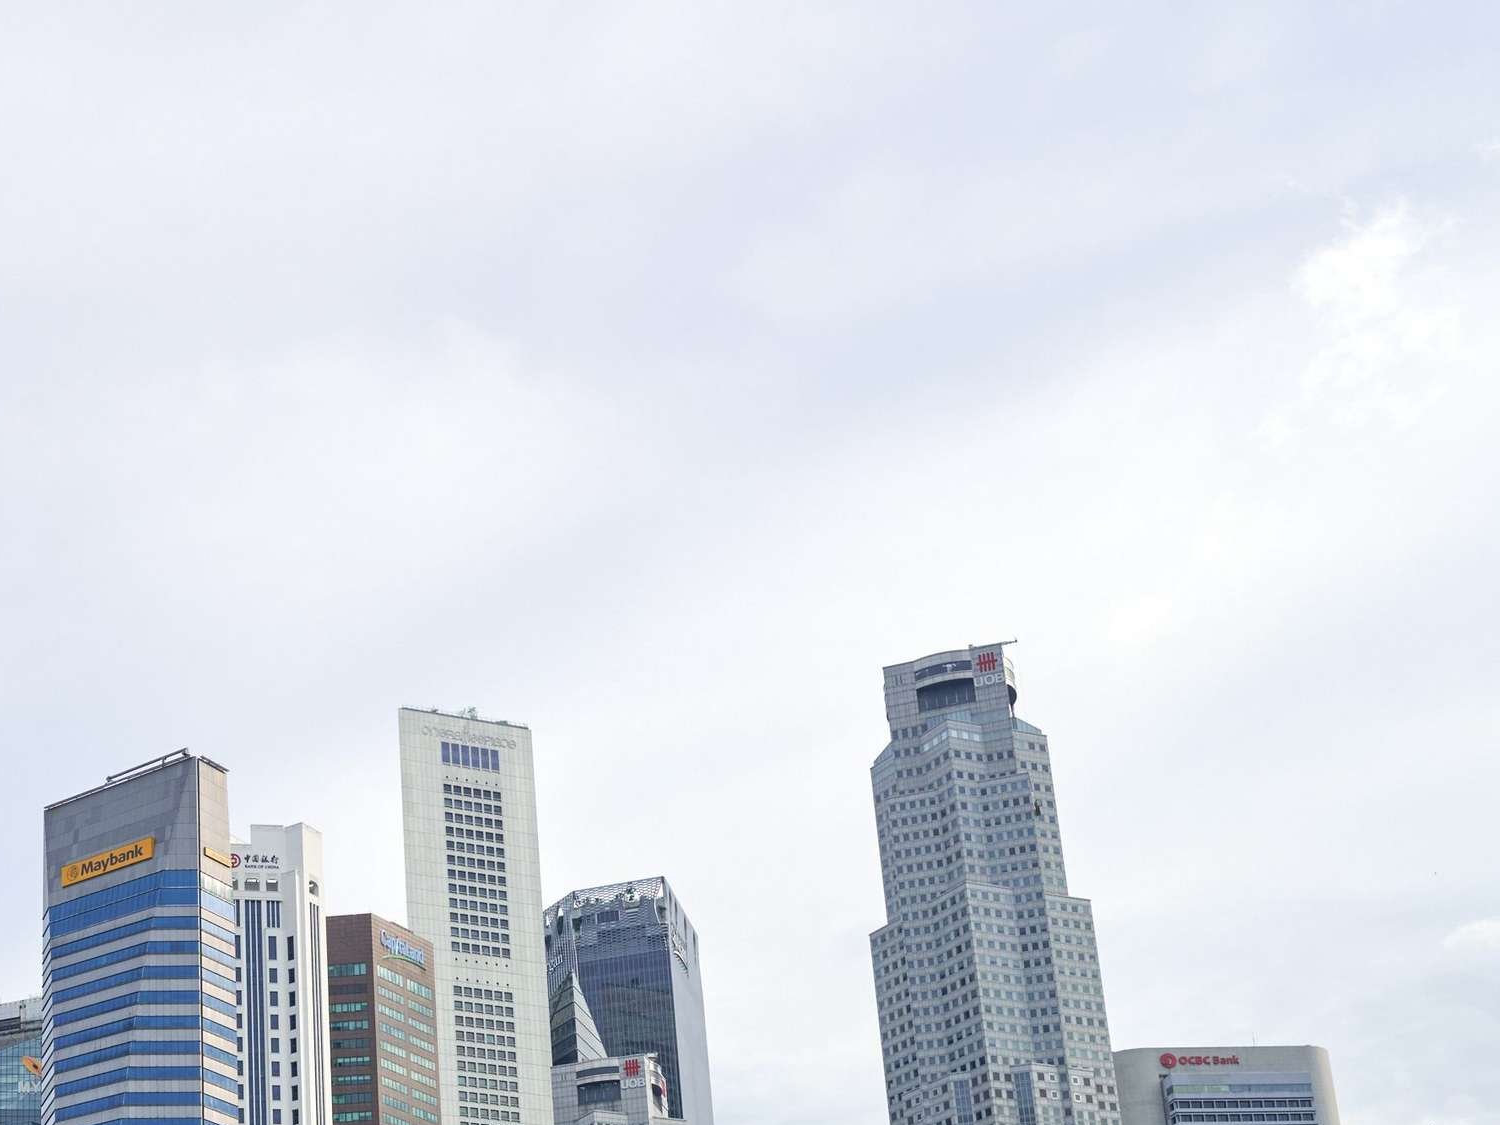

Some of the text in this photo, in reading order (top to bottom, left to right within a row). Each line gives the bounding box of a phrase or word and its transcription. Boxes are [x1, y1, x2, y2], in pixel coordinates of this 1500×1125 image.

[973, 673, 1004, 687] UOB
[81, 844, 143, 876] Maybank
[1179, 1055, 1240, 1065] OCBC Bank
[621, 1077, 646, 1089] UOB
